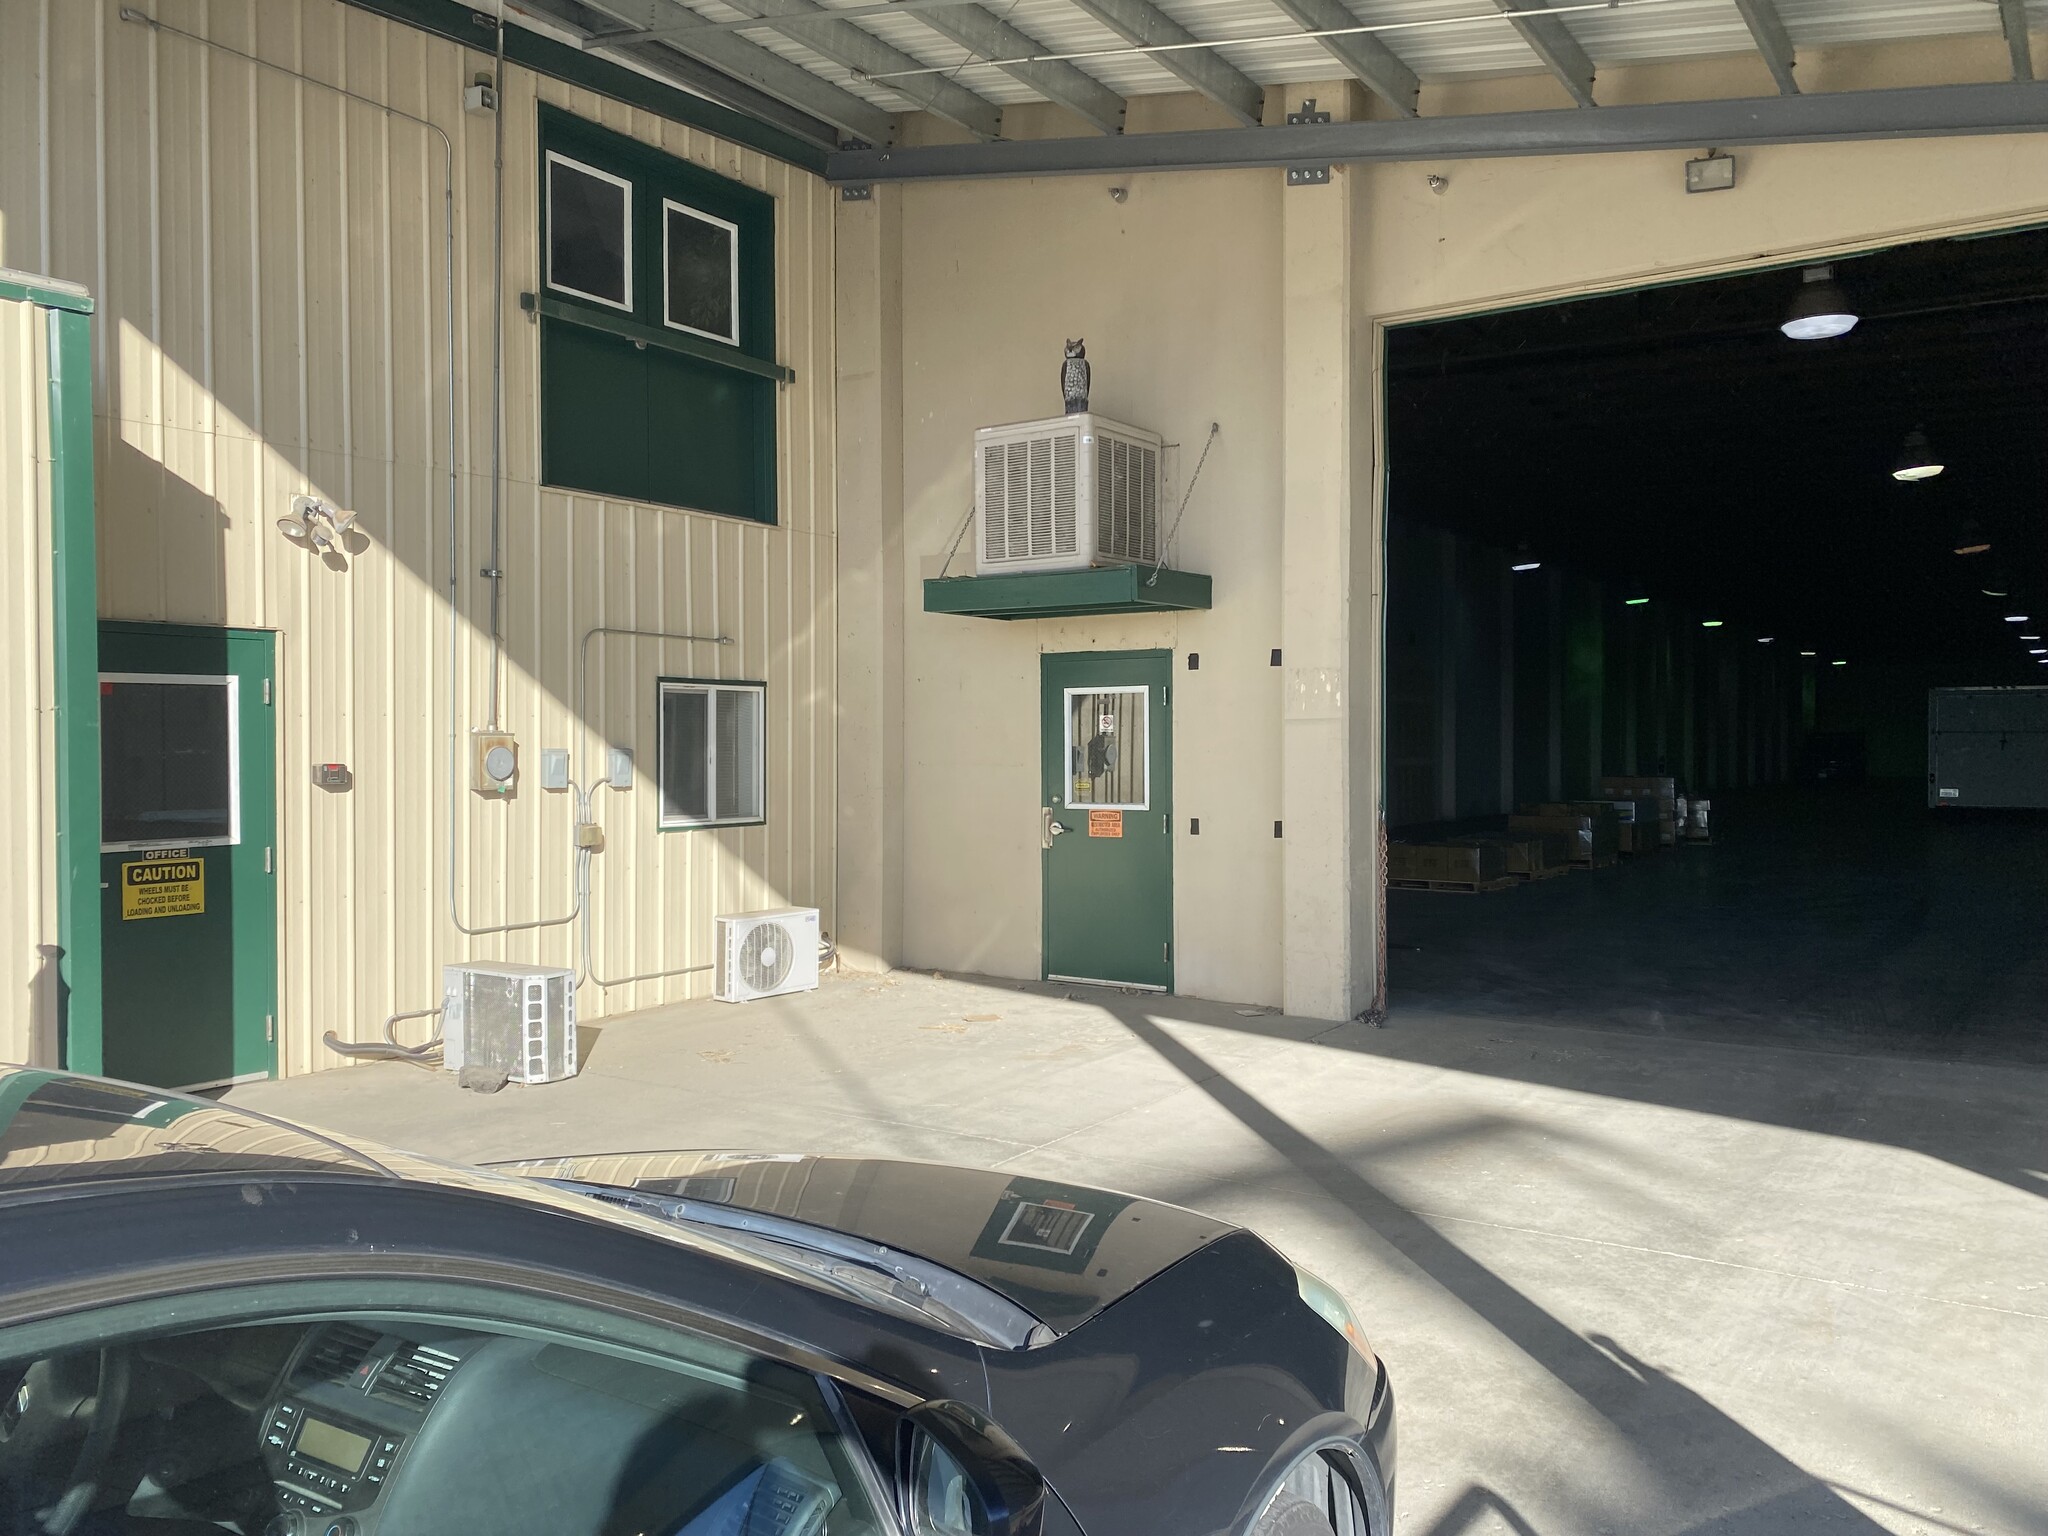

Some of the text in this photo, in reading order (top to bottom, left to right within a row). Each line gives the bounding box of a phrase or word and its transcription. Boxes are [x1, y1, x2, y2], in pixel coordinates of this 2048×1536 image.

[145, 849, 187, 859] OFFICE
[132, 865, 196, 882] CAUTION
[139, 884, 189, 895] WHEELS MUST BE
[138, 894, 190, 905] CHOCKED BEFORE
[127, 902, 200, 916] LOADING AND UNLOADING
